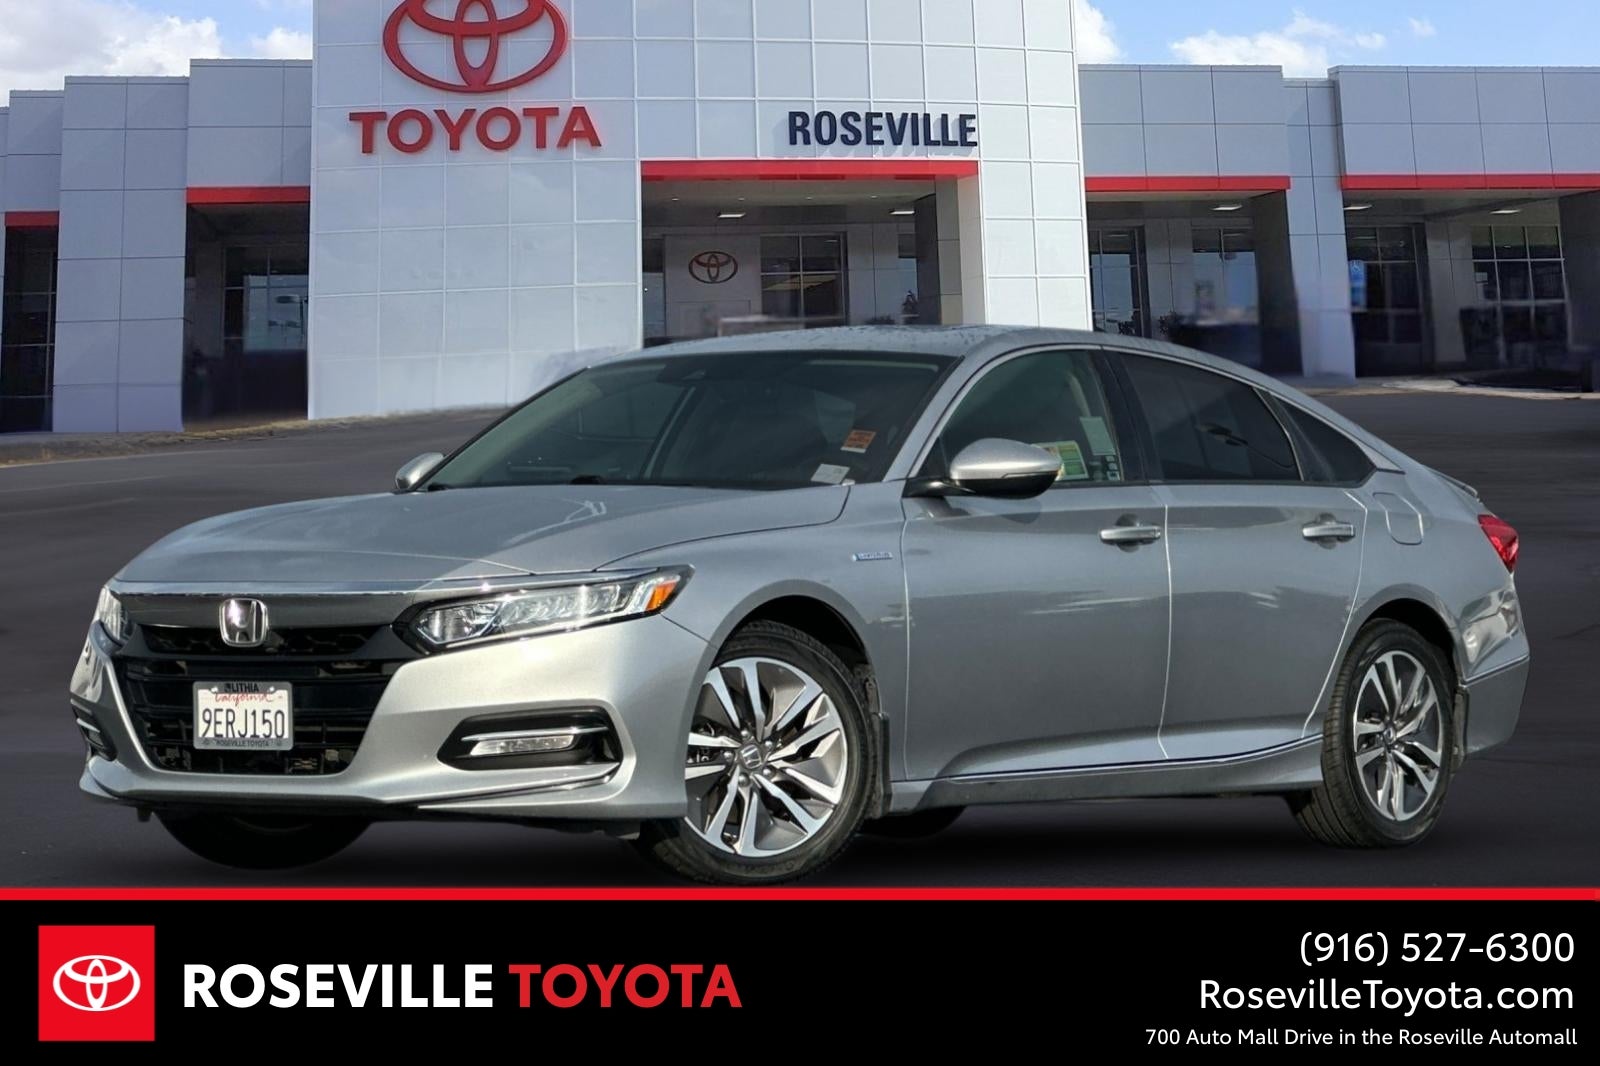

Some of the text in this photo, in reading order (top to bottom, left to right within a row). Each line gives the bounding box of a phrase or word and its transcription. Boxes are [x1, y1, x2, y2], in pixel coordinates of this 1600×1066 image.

[349, 106, 602, 154] TOYOTA
[788, 111, 978, 147] ROSEVILLE
[232, 683, 260, 693] LITHIA
[202, 708, 286, 739] 9ERJ150
